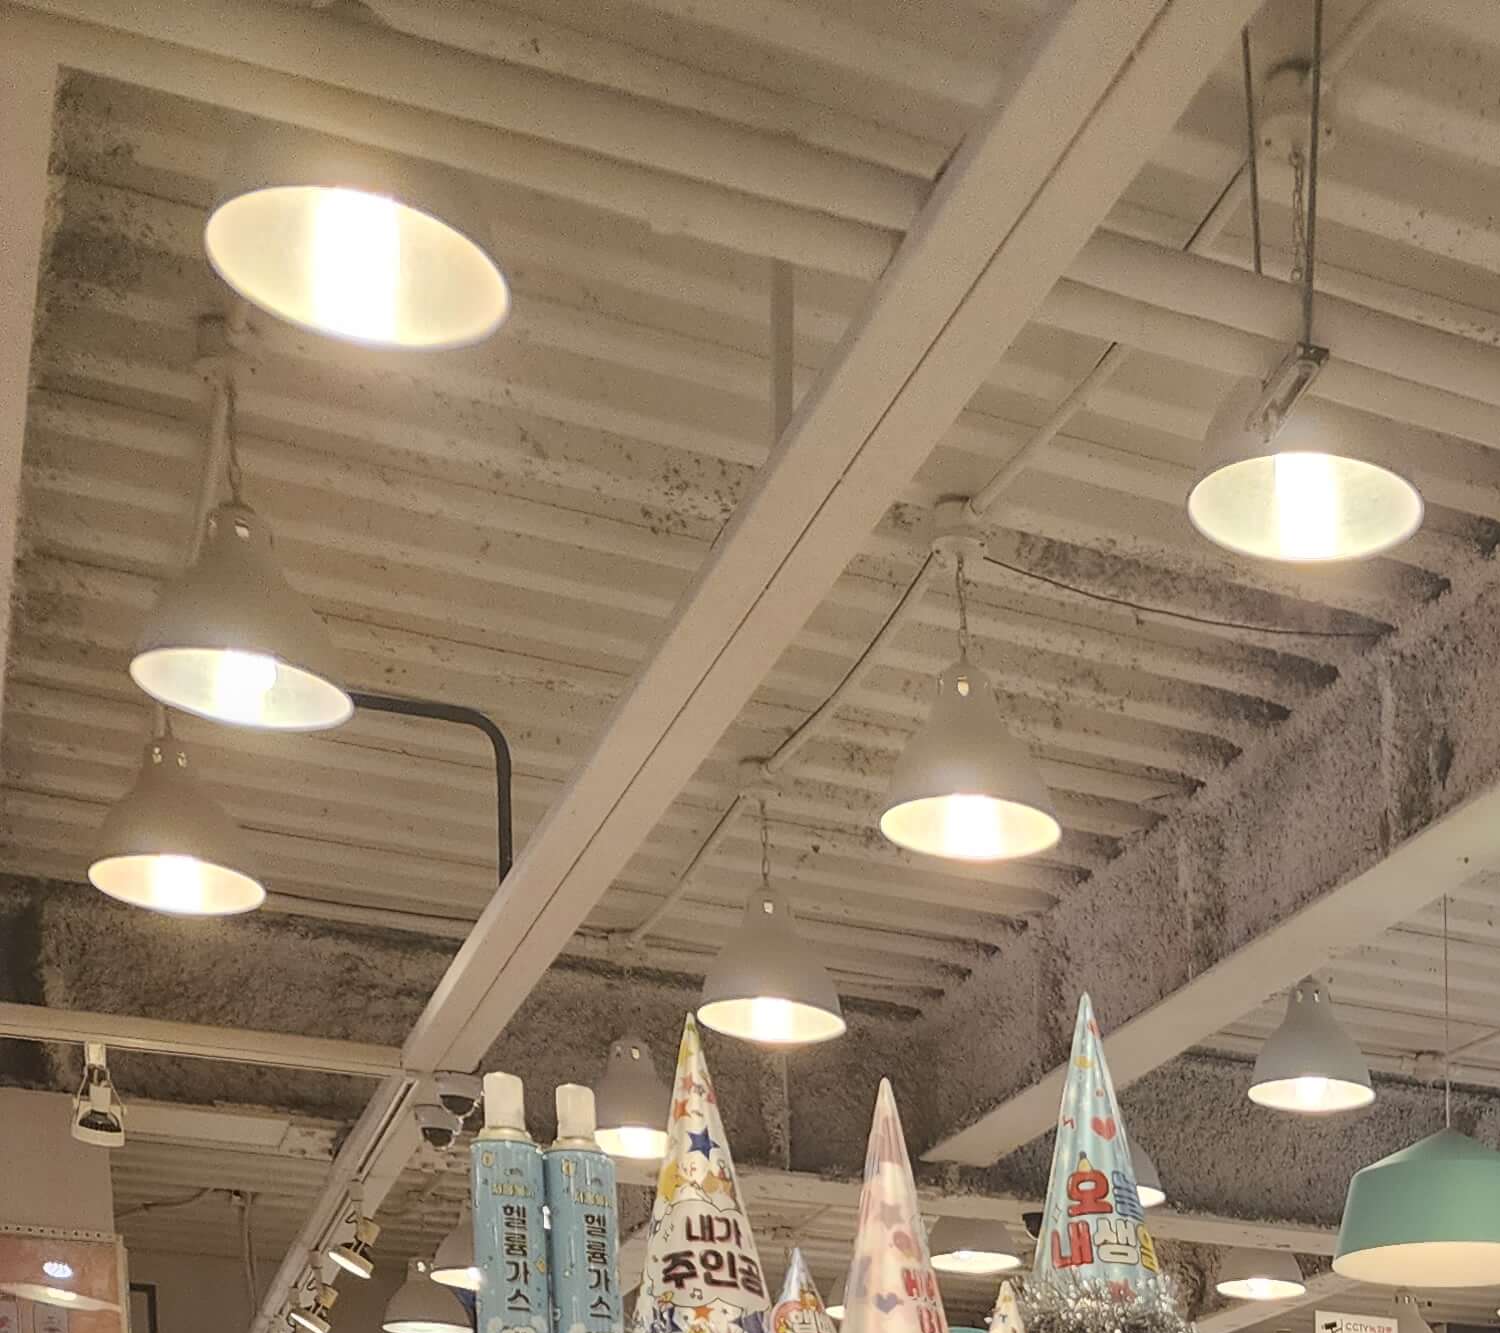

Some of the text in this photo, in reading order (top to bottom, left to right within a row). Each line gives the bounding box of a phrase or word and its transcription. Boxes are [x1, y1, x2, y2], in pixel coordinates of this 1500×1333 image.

[503, 1204, 532, 1313] 헬륨가스
[584, 1213, 613, 1320] 헬륨가스
[685, 1214, 743, 1249] 내가
[662, 1249, 766, 1299] 주인공
